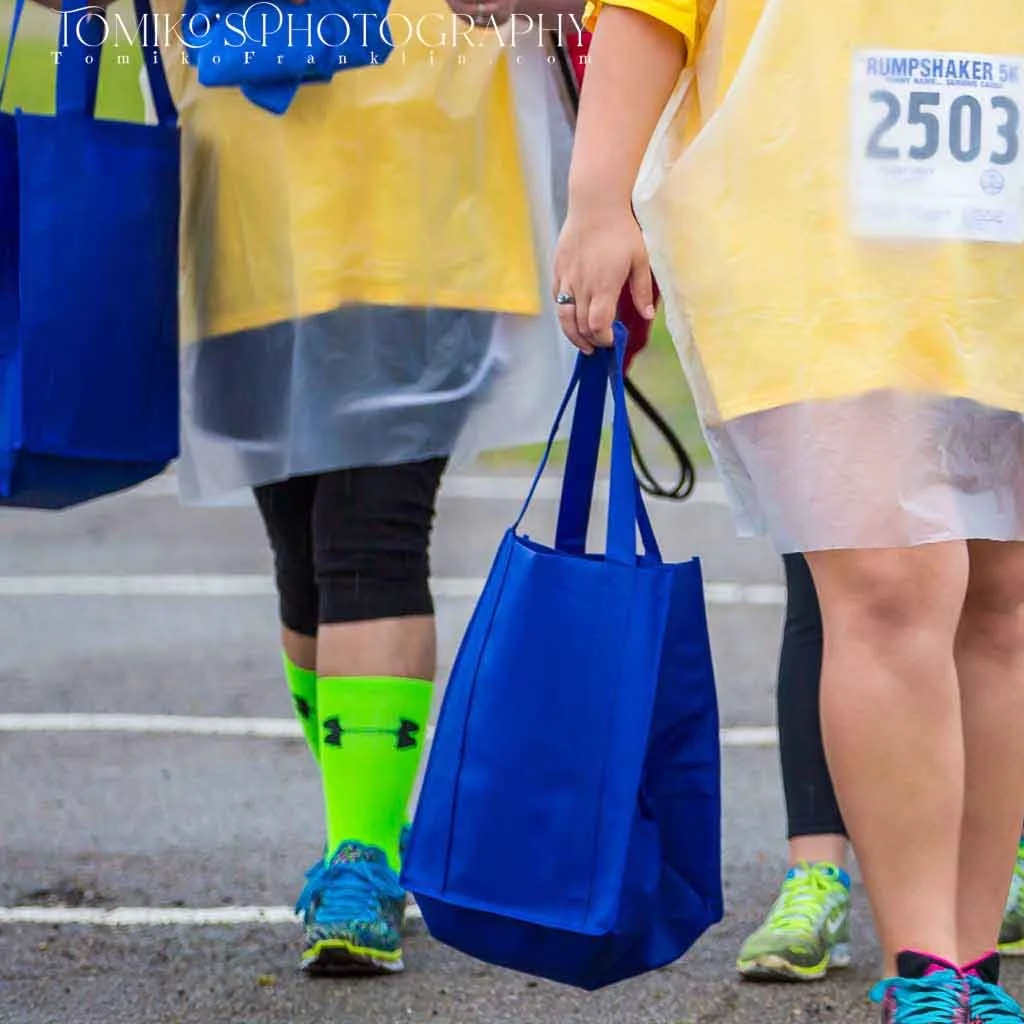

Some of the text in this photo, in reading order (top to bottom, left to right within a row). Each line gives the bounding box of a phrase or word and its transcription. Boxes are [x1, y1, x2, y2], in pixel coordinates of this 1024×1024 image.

[866, 57, 1021, 83] RUMPSHAKER 5K
[866, 89, 1021, 166] 2503
